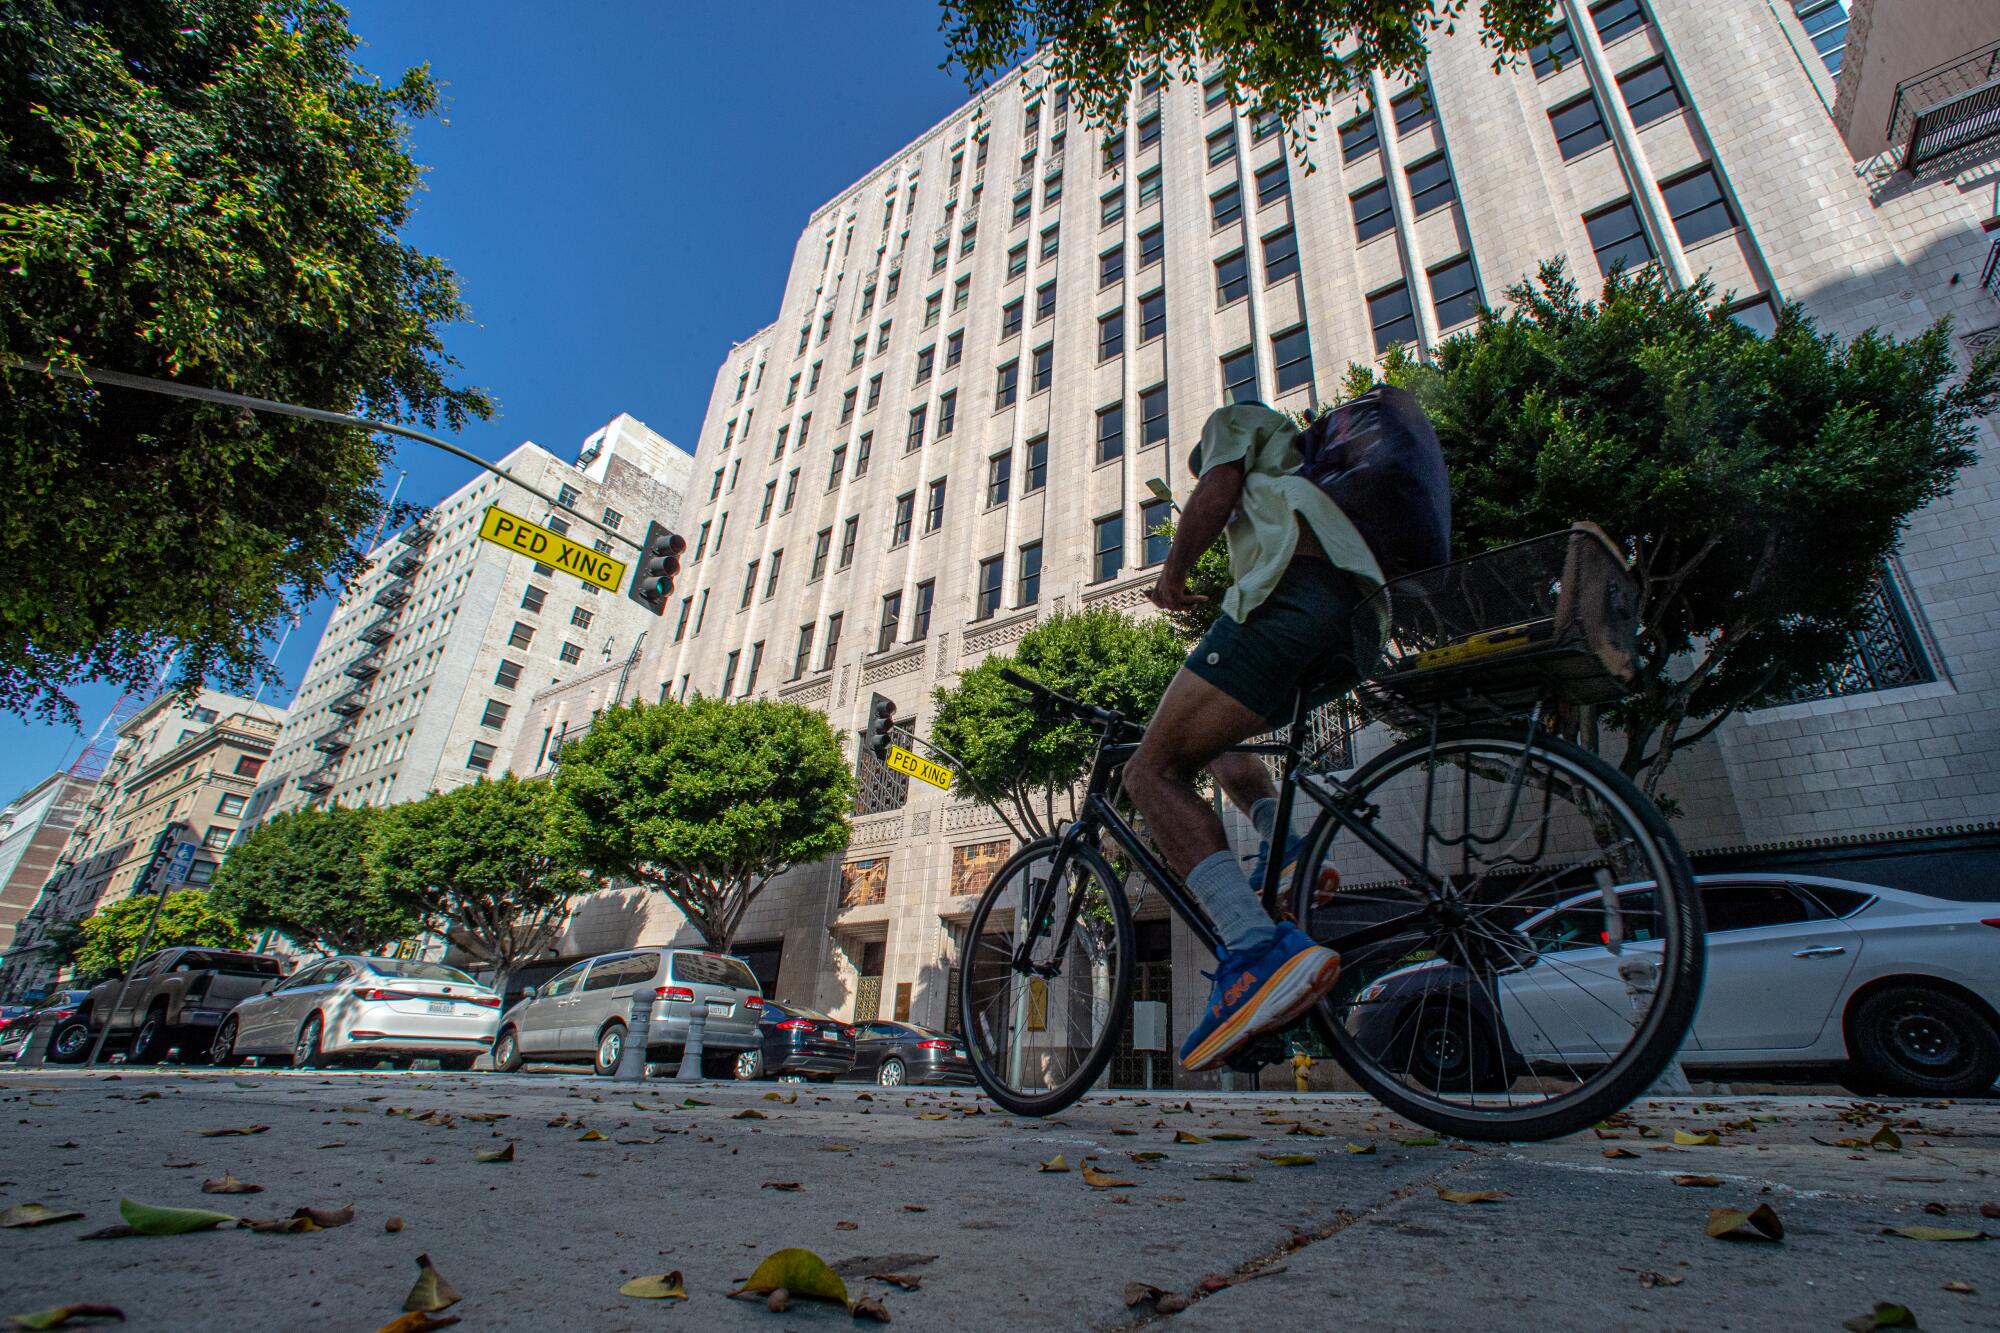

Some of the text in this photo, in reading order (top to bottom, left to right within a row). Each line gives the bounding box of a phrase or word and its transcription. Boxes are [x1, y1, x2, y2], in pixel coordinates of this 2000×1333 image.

[494, 516, 613, 583] PED XING
[893, 751, 947, 785] PED XING
